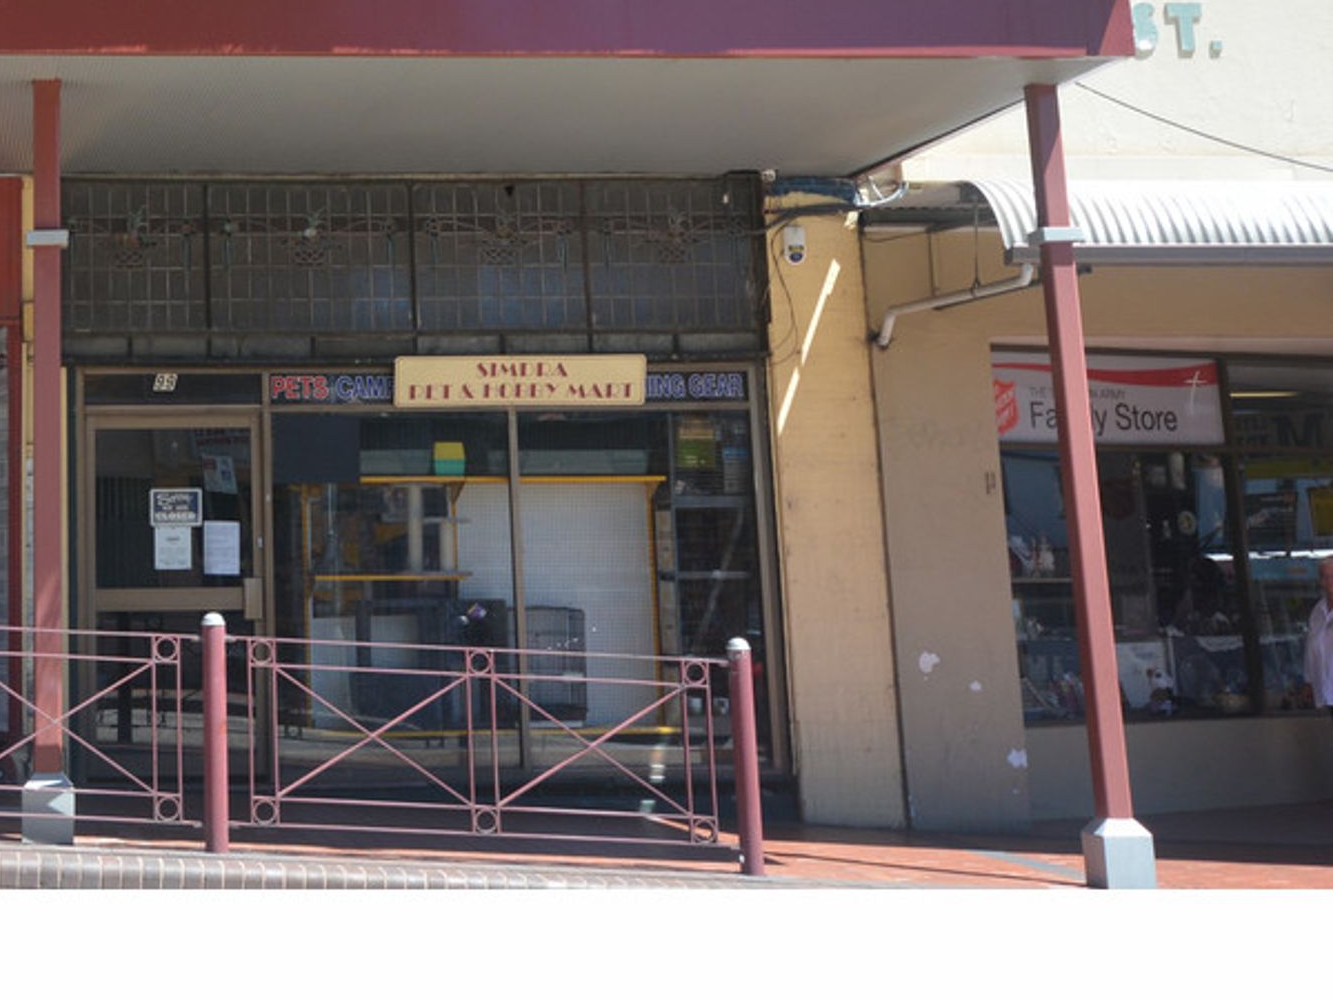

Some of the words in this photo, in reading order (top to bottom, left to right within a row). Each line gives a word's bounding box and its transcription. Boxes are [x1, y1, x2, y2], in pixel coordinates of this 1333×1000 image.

[271, 375, 330, 400] PETS
[688, 372, 745, 398] GEAR
[409, 384, 453, 400] PET
[459, 382, 475, 400] &
[483, 382, 556, 400] HOBBY
[565, 382, 633, 400] MART
[1115, 402, 1178, 432] Store
